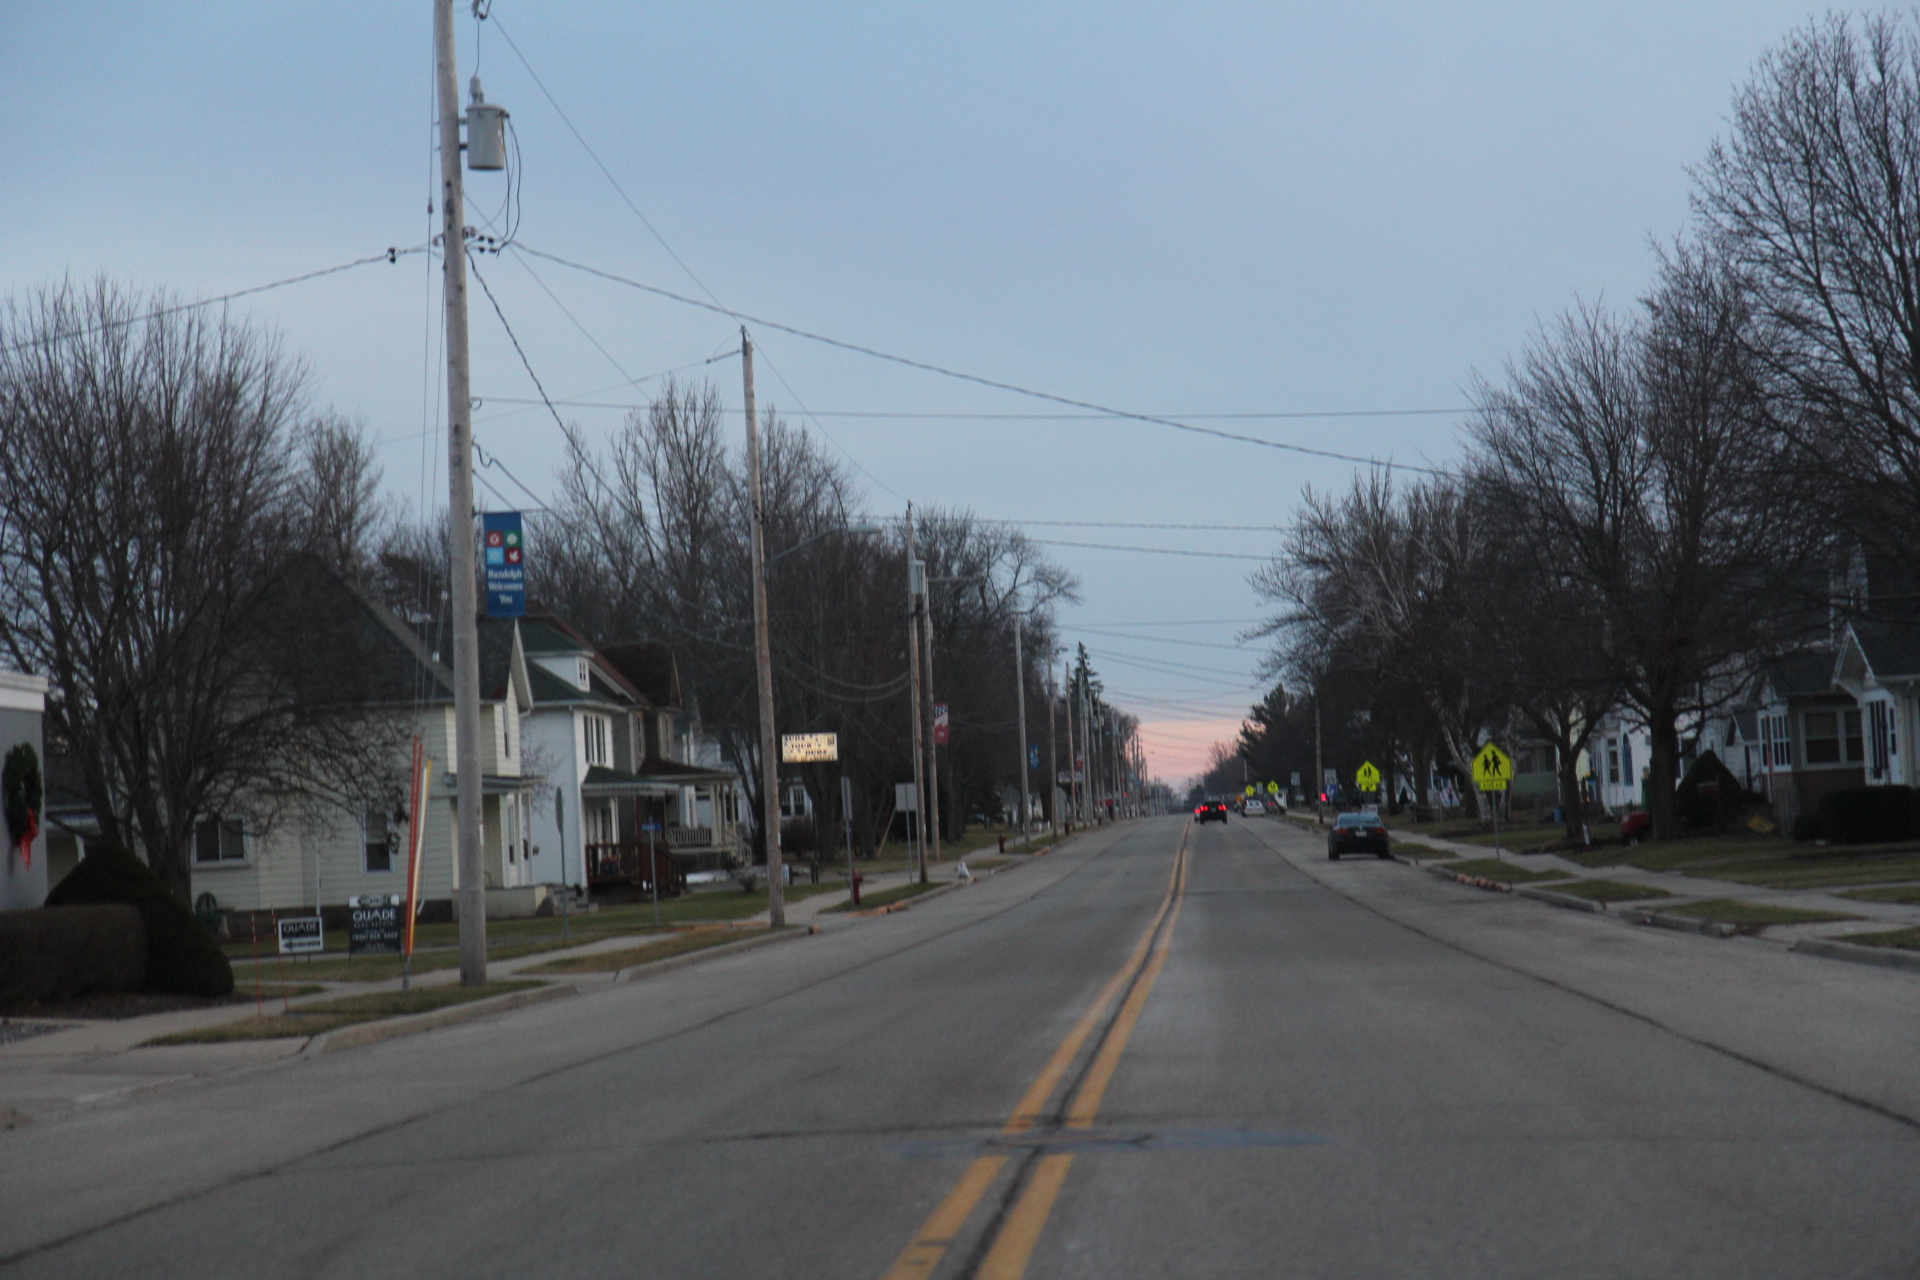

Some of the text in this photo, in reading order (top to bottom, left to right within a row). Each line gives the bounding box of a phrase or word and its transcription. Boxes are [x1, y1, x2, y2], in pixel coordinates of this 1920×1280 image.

[488, 569, 522, 580] Randolph
[488, 582, 523, 591] Welcomes
[499, 594, 513, 604] You
[353, 908, 396, 922] QUADE
[283, 922, 317, 933] QUADE
